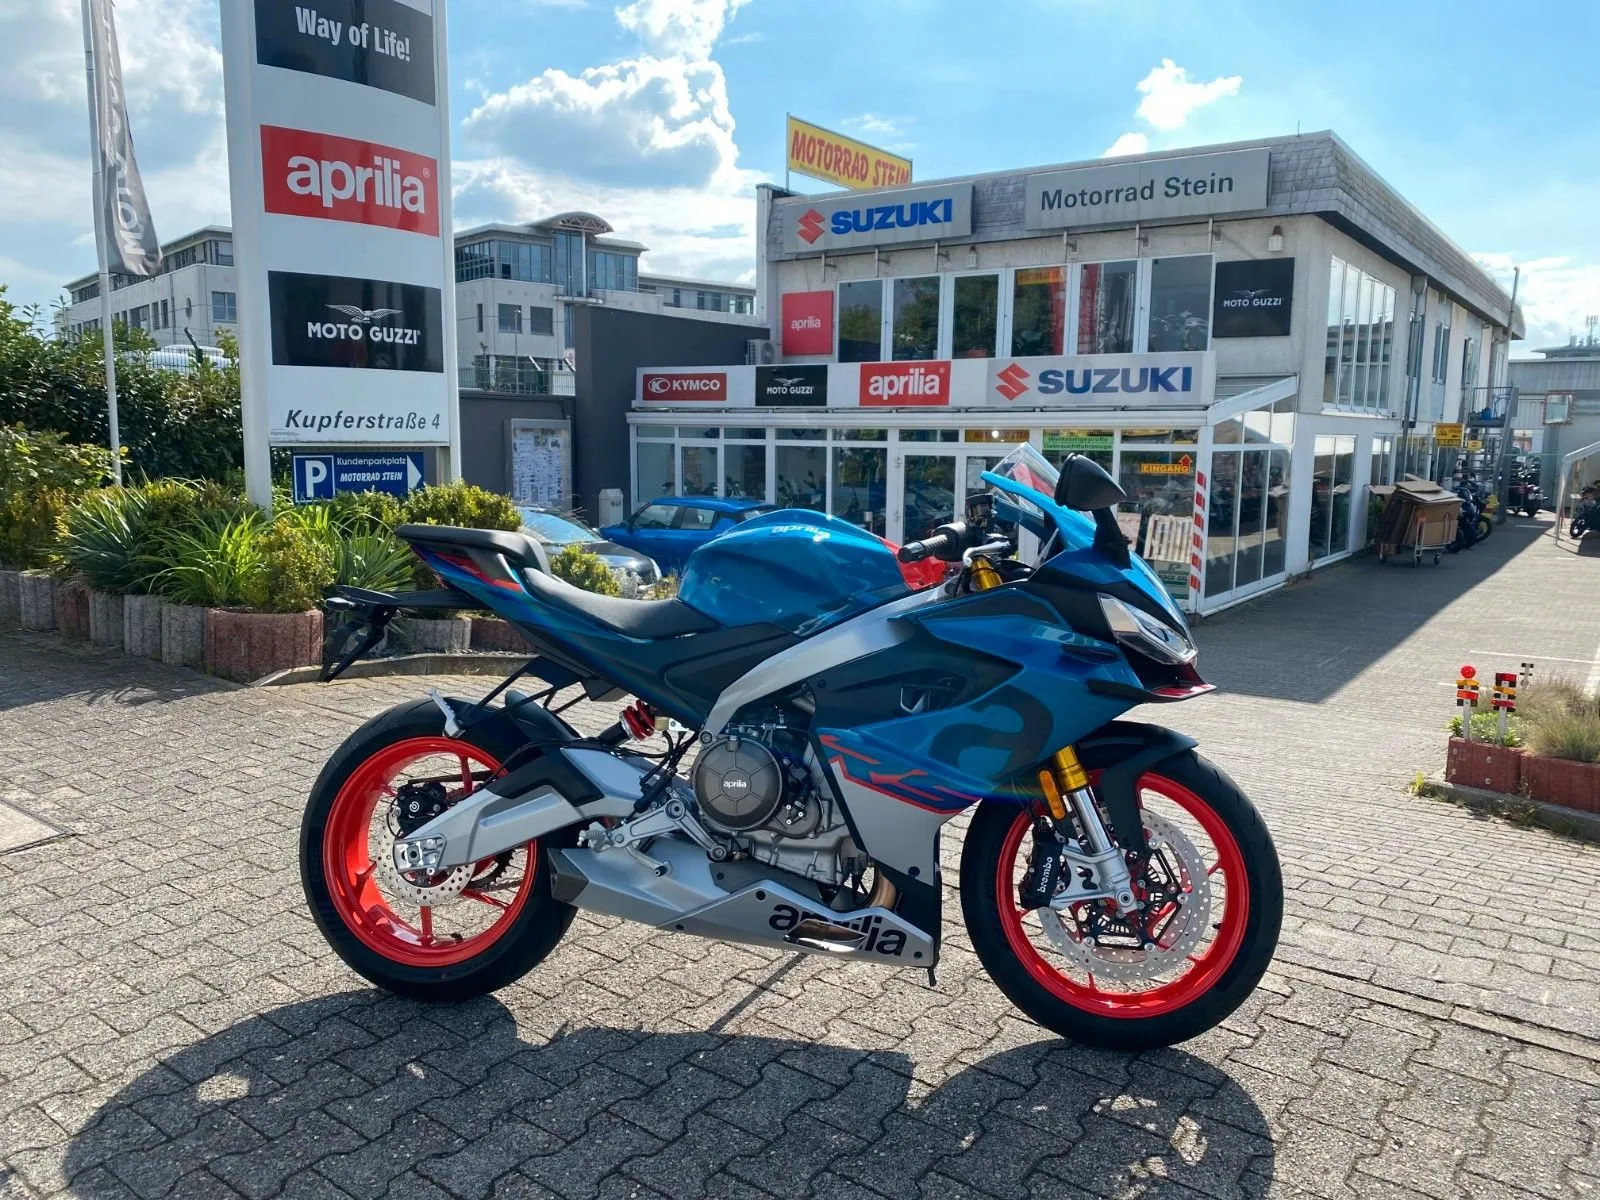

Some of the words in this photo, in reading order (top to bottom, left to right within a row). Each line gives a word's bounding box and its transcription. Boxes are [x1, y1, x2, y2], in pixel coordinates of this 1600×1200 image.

[295, 6, 342, 45] Way
[349, 22, 369, 48] of
[374, 27, 411, 62] Life!
[791, 130, 869, 183] MOTORRAD
[872, 159, 909, 187] STEIN
[286, 155, 425, 214] aprilia
[1041, 179, 1155, 211] Motorrad
[1164, 172, 1233, 198] Stein
[831, 198, 952, 235] SUZUKI
[1223, 299, 1250, 308] MOTO
[1252, 298, 1282, 307] GUZZI
[307, 321, 363, 341] MOTO
[369, 326, 417, 345] GUZZI
[791, 315, 821, 331] aprilia
[672, 379, 720, 391] KYMCO
[766, 386, 788, 395] MOTO
[790, 386, 813, 395] GUZZI
[868, 368, 940, 400] aprilia
[1037, 366, 1193, 394] SUZUKI
[285, 409, 426, 432] Kupferstraße
[432, 413, 440, 429] 4
[336, 457, 406, 466] Kundenparkplatz
[305, 460, 327, 497] P
[340, 472, 380, 482] MOTORRAD
[381, 471, 403, 481] STEIN
[723, 779, 747, 789] aprilia
[1037, 856, 1053, 893] brembo
